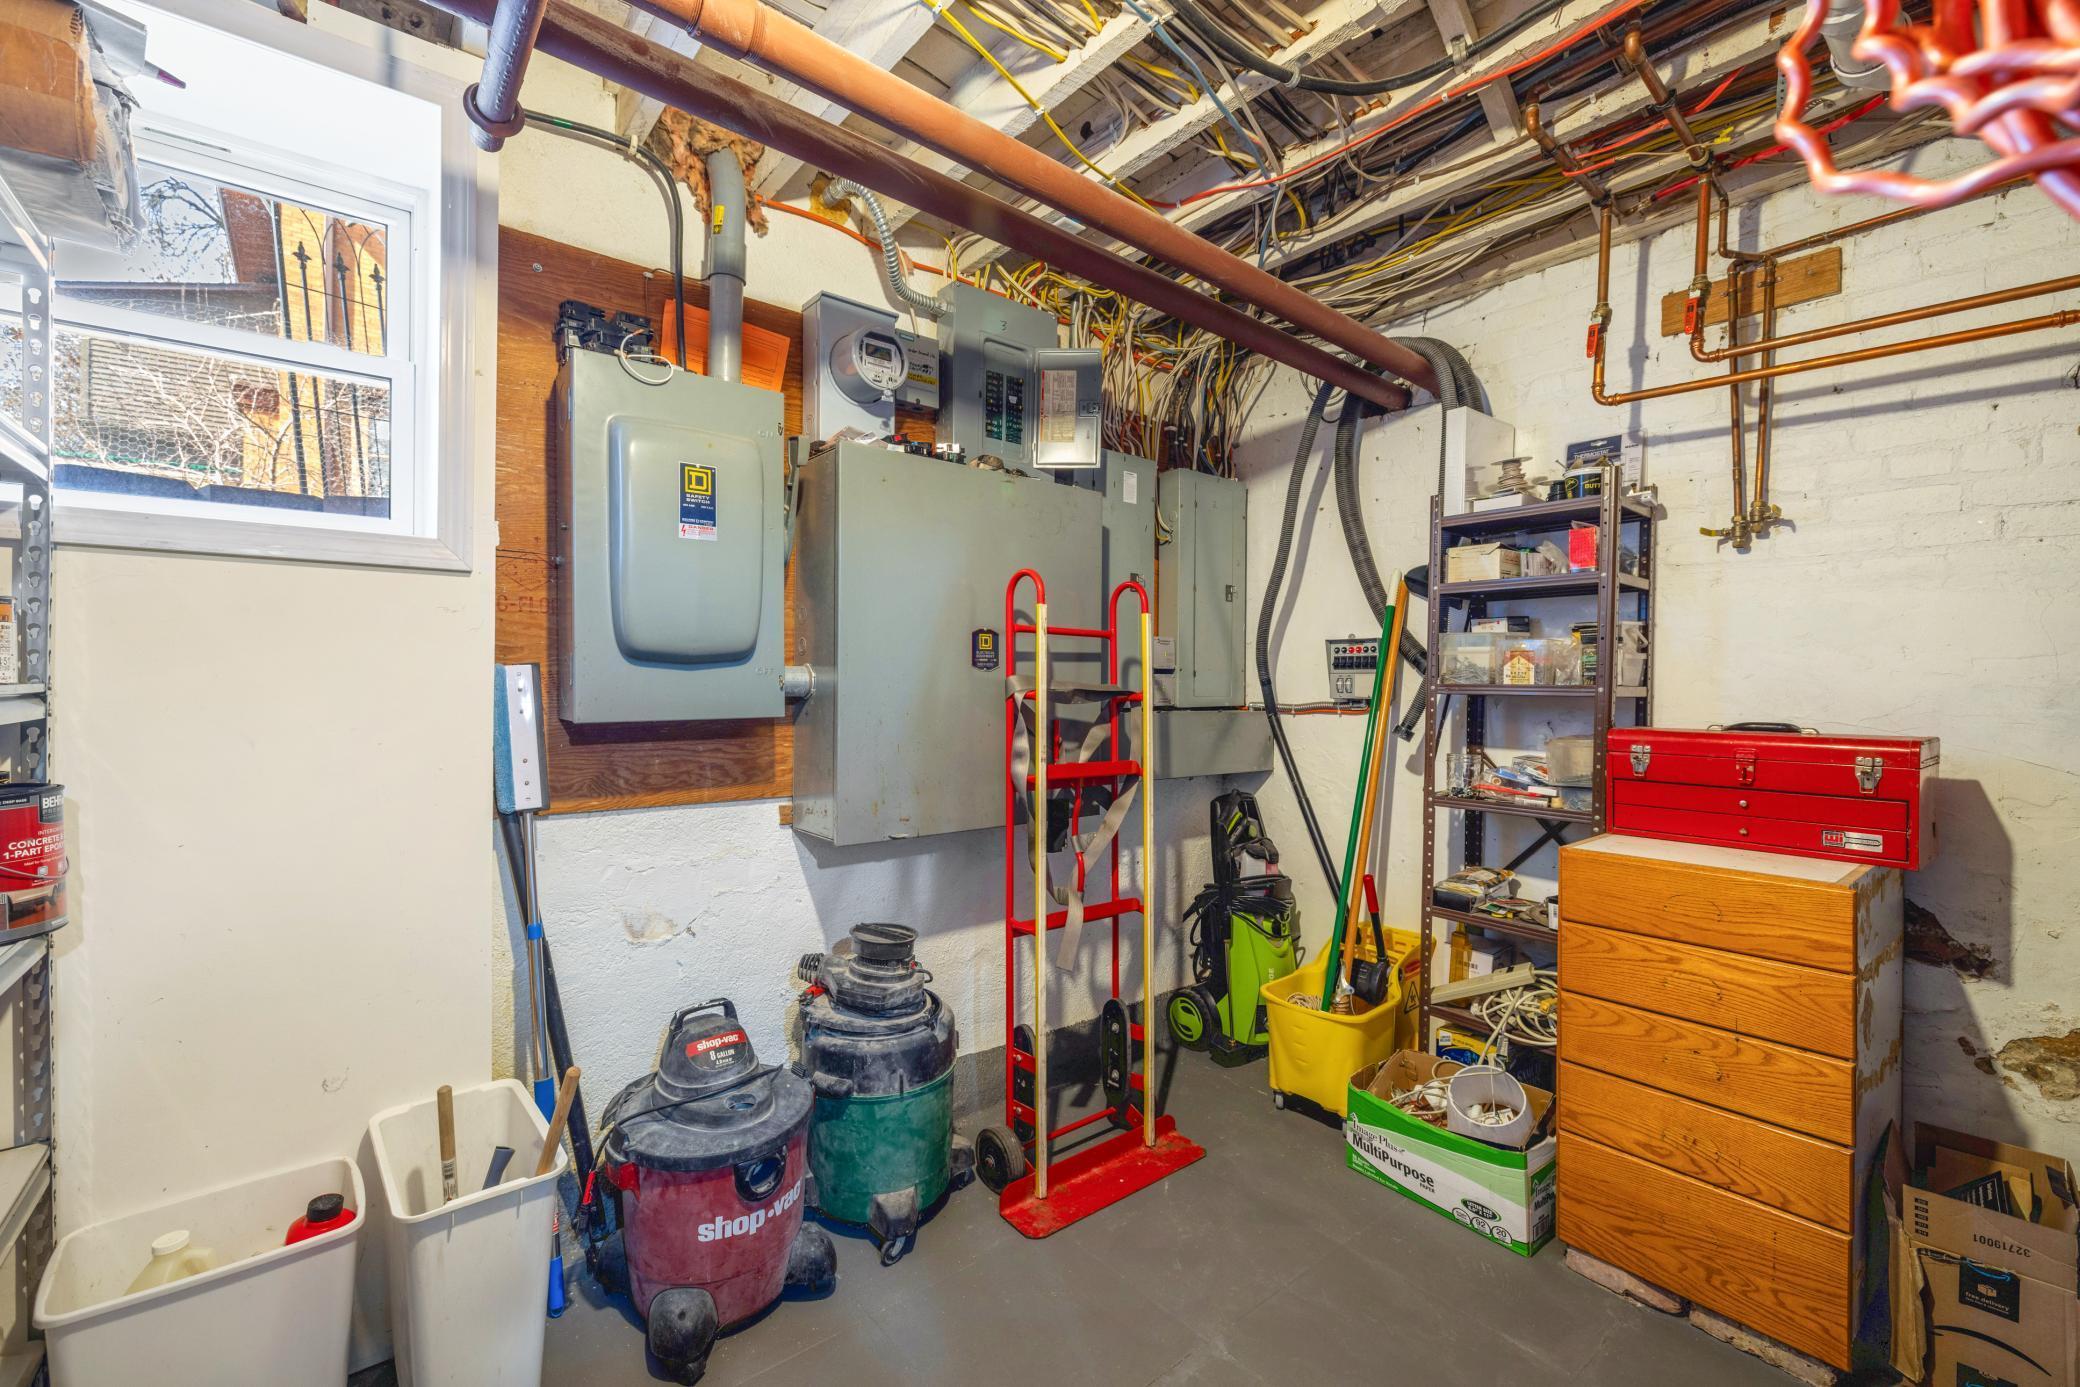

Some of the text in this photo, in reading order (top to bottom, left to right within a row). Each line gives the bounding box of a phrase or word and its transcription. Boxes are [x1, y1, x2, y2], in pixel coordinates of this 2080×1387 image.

[8, 835, 60, 850] CONCRETE
[3, 846, 42, 860] 1-PART
[709, 1050, 717, 1061] 8
[716, 1048, 735, 1059] GALLON
[1353, 1119, 1398, 1153] Image Plus
[1352, 1133, 1435, 1188] MultiPurpose
[1475, 1218, 1486, 1229] 92
[1496, 1227, 1507, 1238] 20
[1973, 1233, 2031, 1258] 32719001
